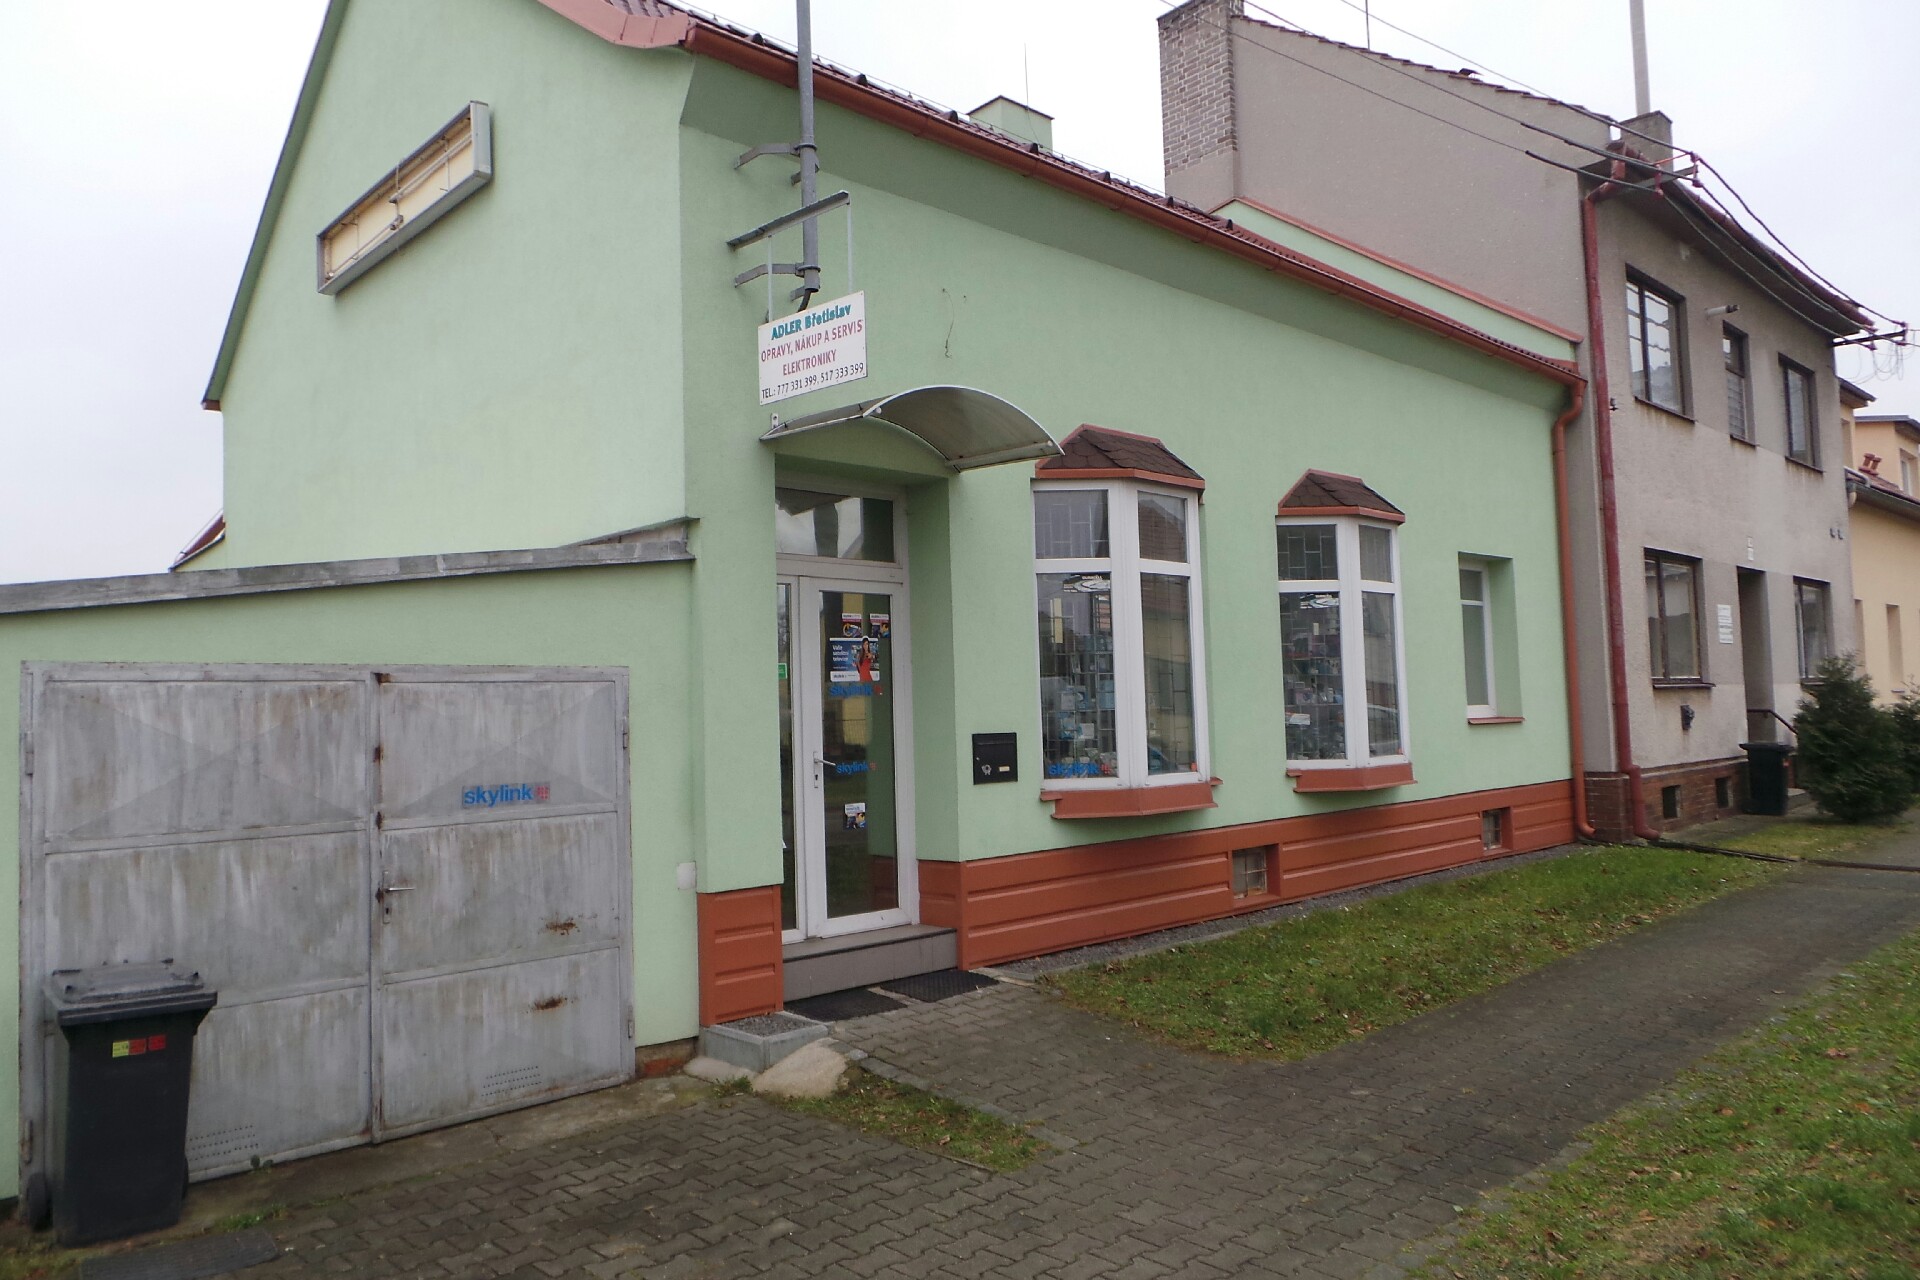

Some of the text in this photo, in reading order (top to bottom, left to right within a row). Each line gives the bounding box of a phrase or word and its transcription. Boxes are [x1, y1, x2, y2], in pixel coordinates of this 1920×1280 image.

[772, 305, 851, 340] ADLER Břetislav
[761, 320, 863, 363] OPRAVY, NÁKUP A SERVIS
[783, 350, 836, 376] ELEKTRONIKY
[762, 388, 776, 399] TEL.:
[777, 382, 789, 395] 777
[791, 378, 803, 392] 331
[821, 370, 833, 383] 517
[835, 366, 849, 379] 333
[850, 362, 864, 376] 399
[836, 760, 869, 775] skylink
[464, 784, 533, 807] skylink
